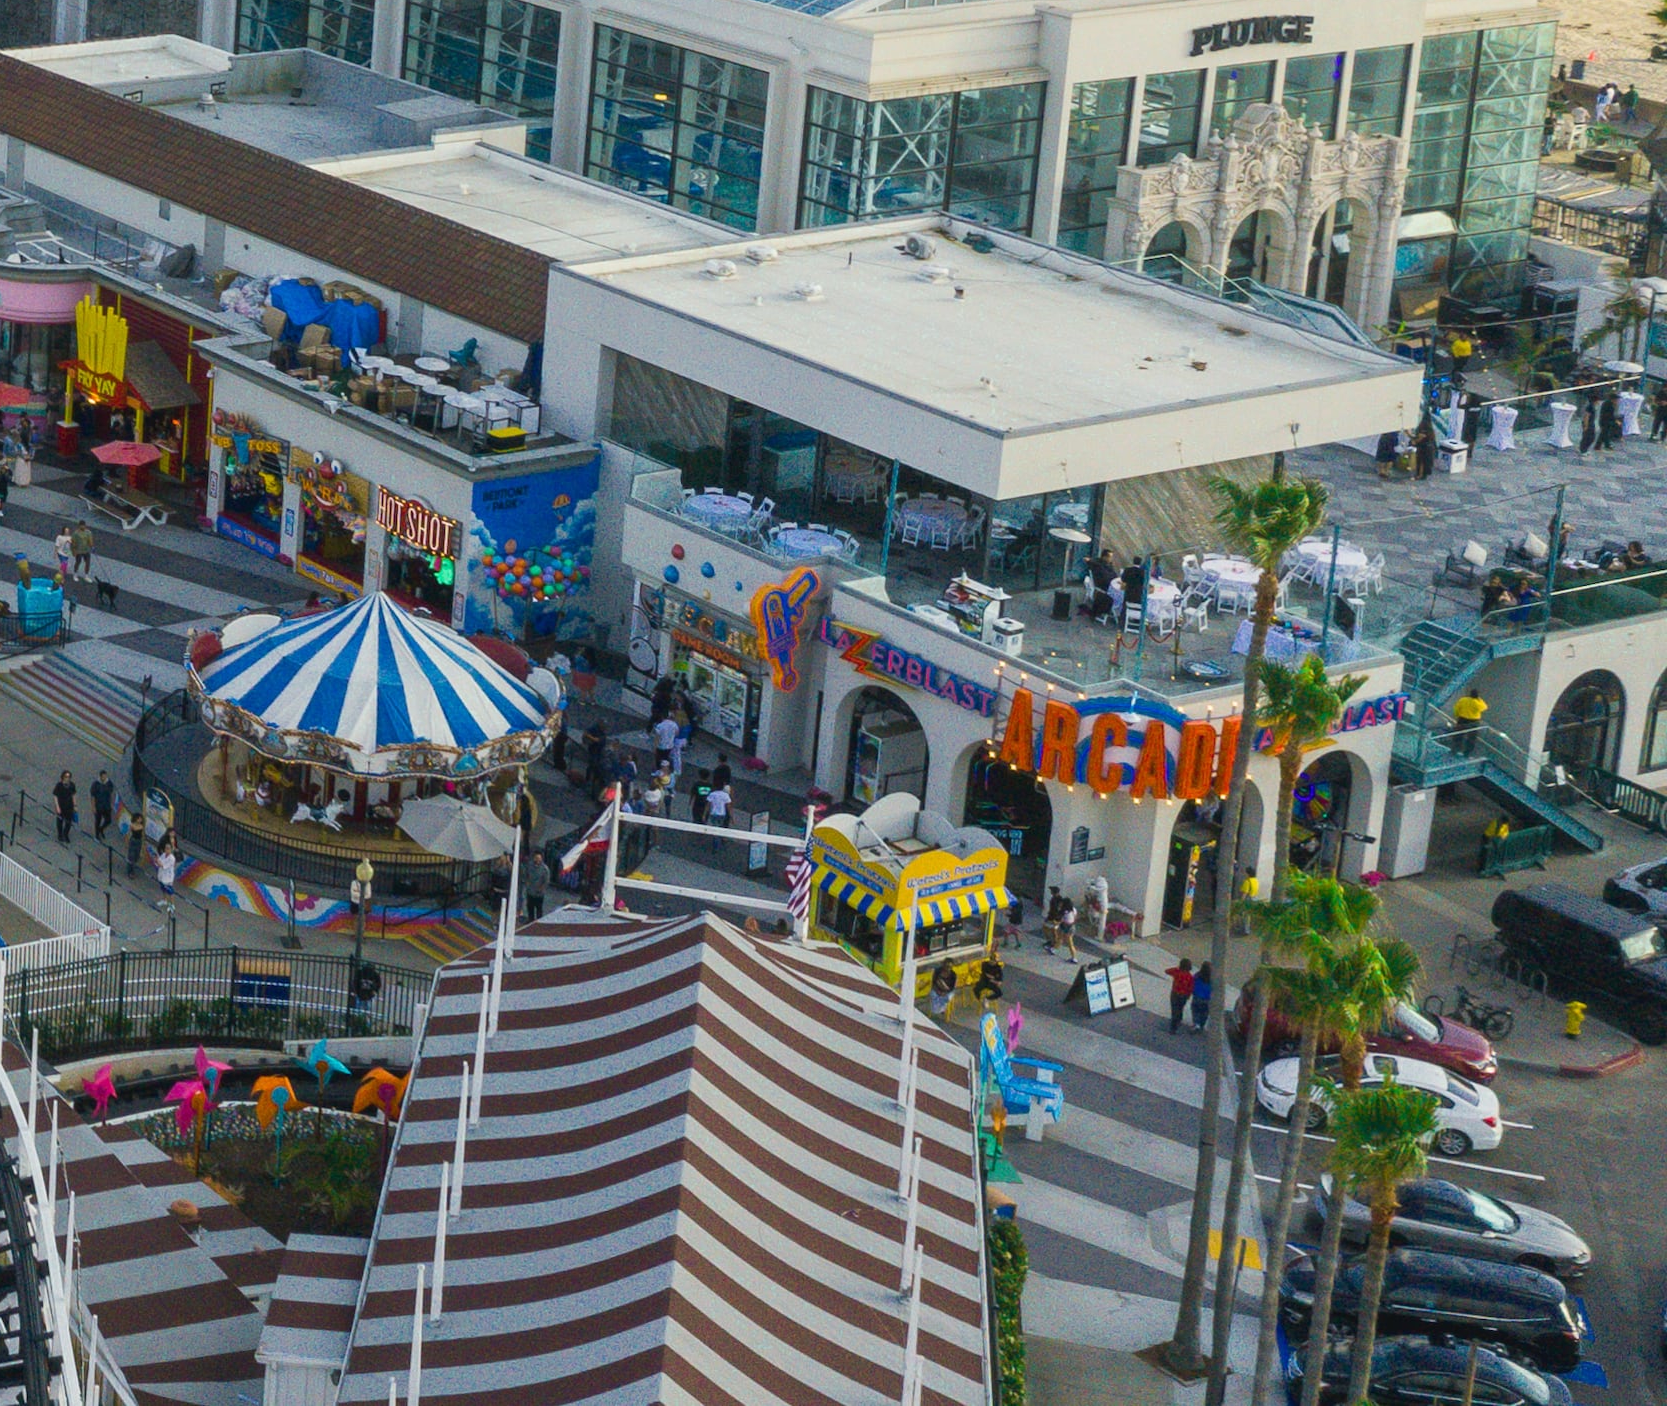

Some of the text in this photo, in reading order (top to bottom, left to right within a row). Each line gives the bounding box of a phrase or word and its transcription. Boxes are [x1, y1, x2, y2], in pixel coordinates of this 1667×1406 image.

[1189, 15, 1314, 56] PLUNGE
[77, 368, 116, 397] FRY YAY
[248, 439, 281, 454] TOSS
[377, 490, 405, 534] HOT
[405, 506, 455, 556] SHOT
[820, 615, 999, 718] LAZERBLAST
